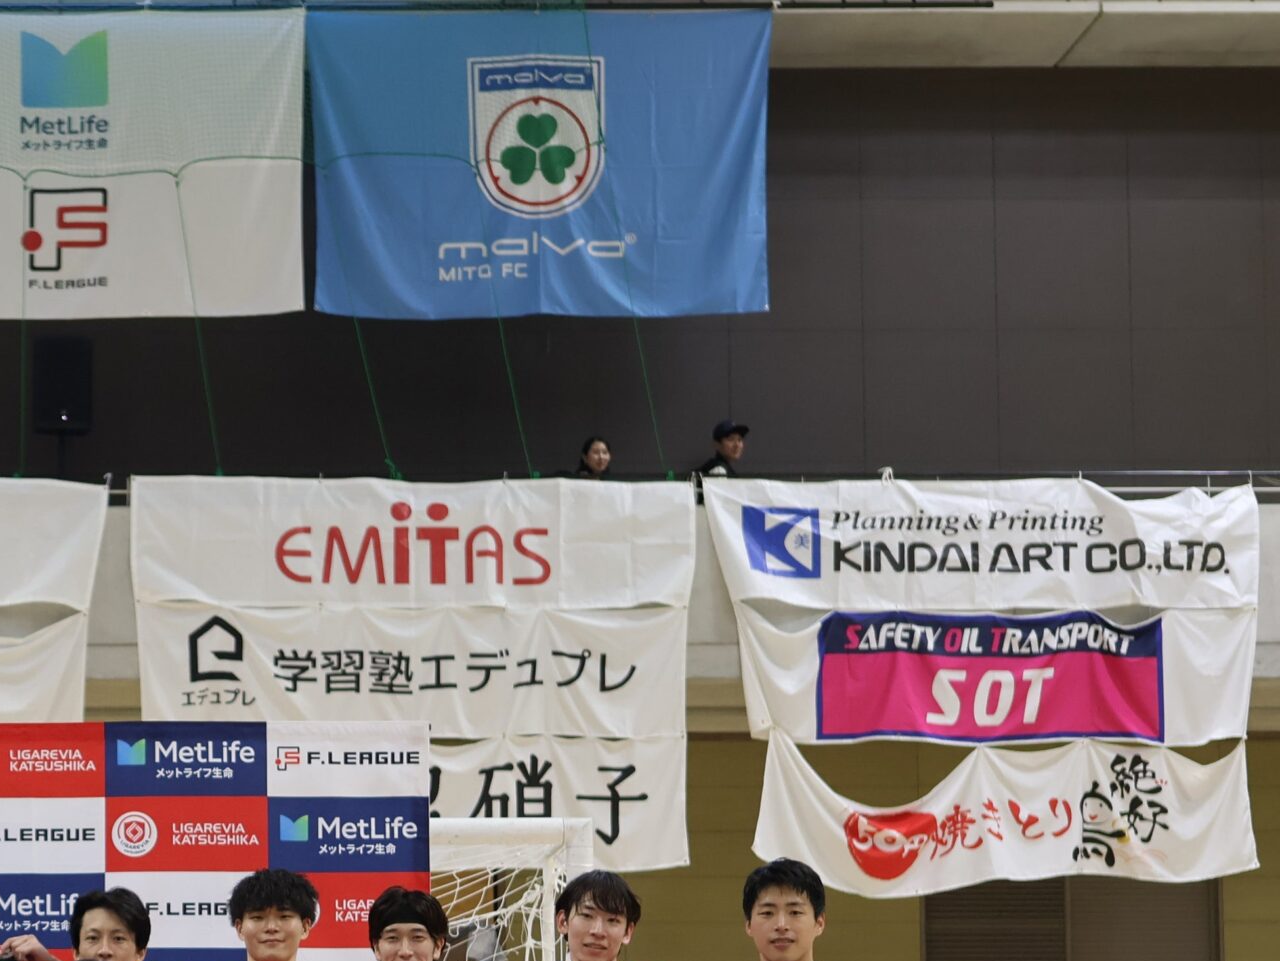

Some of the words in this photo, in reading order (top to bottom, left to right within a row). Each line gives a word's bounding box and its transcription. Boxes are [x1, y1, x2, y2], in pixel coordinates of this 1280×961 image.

[20, 115, 109, 135] MetLife
[438, 265, 491, 281] MITO
[502, 263, 528, 279] FC
[28, 276, 108, 289] F.LEAGUE
[831, 509, 959, 535] Planning
[987, 510, 1105, 536] Printing
[833, 539, 979, 574] KINDAI
[989, 541, 1079, 574] ART
[844, 622, 941, 652] SAFETY
[945, 628, 983, 654] OIL
[991, 621, 1134, 656] TRANSPORT
[273, 647, 637, 695] 学習塾エデュプレ
[182, 688, 256, 707] エデュプレ
[926, 666, 1054, 727] SOT
[9, 749, 82, 760] LIGAREVIA
[155, 740, 255, 763] MetLife
[307, 750, 419, 765] F.LEAGUE
[9, 761, 96, 772] KATSUSHIKA
[156, 767, 234, 779] メットライフ生命
[172, 823, 245, 834] LIGAREVIA
[318, 816, 417, 839] MetLife
[172, 834, 259, 846] KATSUSHIKA
[318, 843, 396, 855] メットライフ生命
[147, 903, 229, 916] F.LEAG
